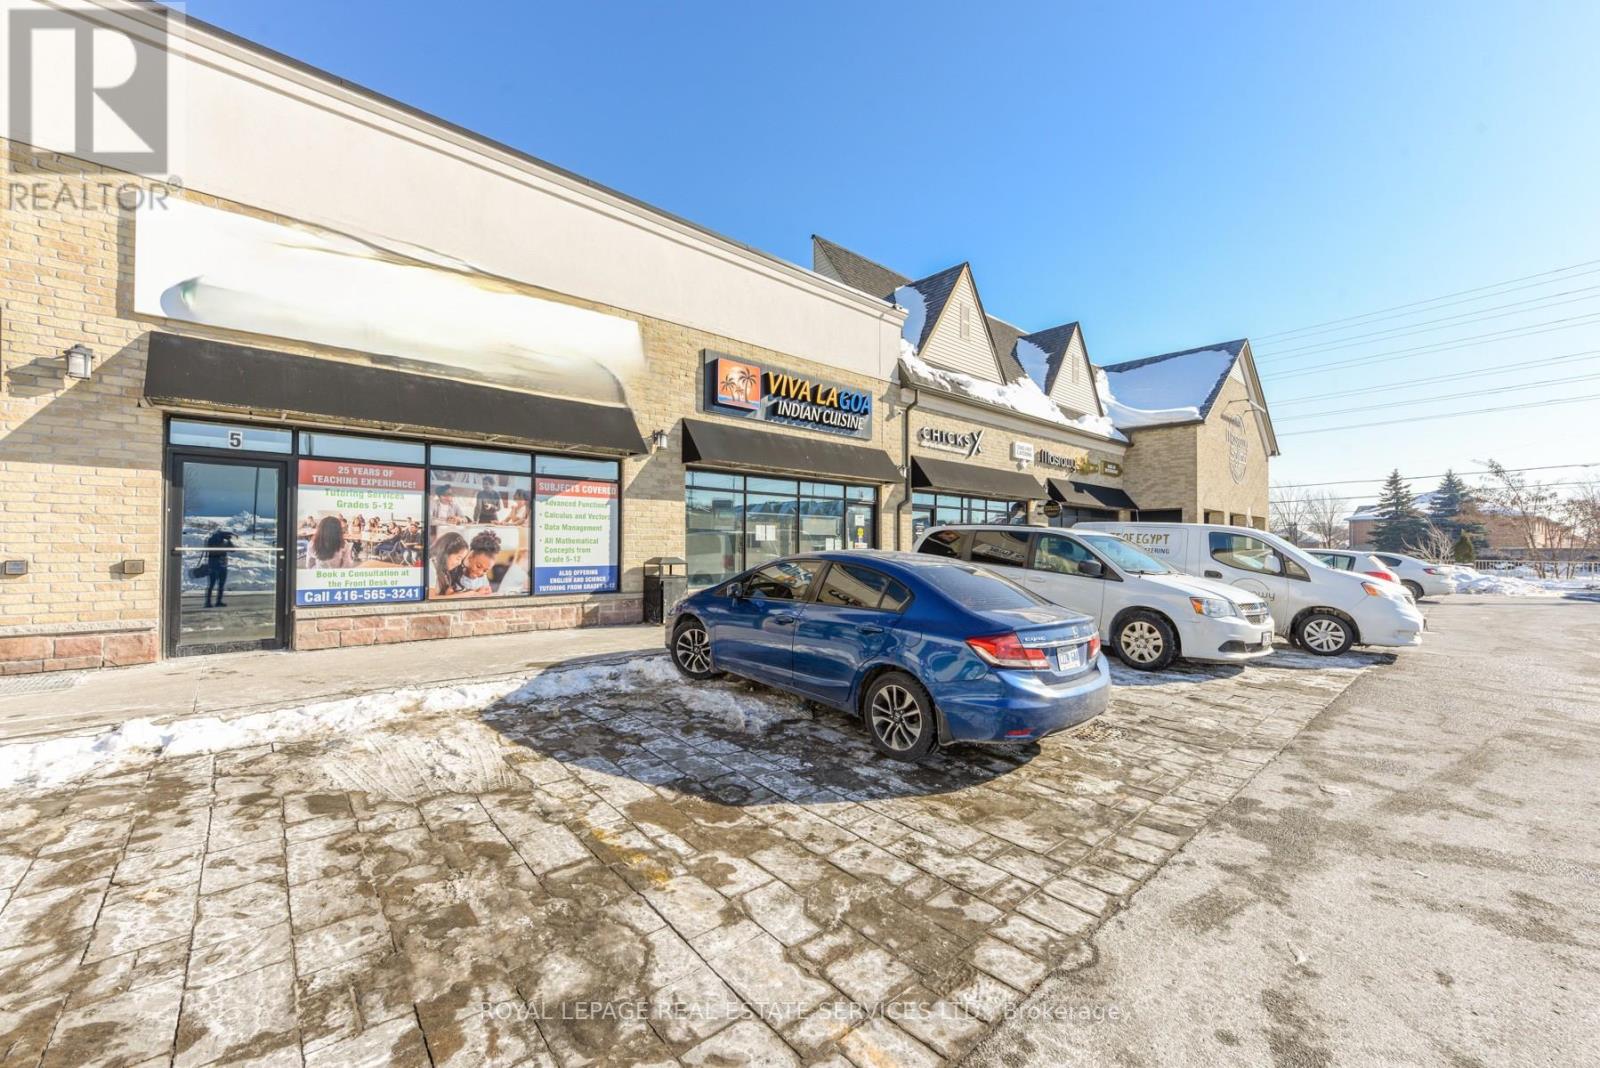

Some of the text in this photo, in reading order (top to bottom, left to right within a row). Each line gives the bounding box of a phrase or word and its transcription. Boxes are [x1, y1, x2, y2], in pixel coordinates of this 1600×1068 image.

[768, 371, 811, 401] VIVA
[777, 401, 865, 430] INDIAN CUISINE
[230, 432, 241, 448] 5
[337, 466, 395, 478] 25 YEARS OF
[312, 475, 416, 489] TEACHING EXPERIENCE!
[324, 487, 405, 500] Tutoring Services
[538, 482, 617, 495] SUBJECTS COVERED
[336, 500, 394, 510] Grades 5-12
[545, 500, 577, 508] Advanced
[544, 511, 573, 519] Calculus
[544, 523, 603, 532] Data Management
[544, 537, 599, 545] All Mathematical
[1136, 533, 1170, 545] EGYPT
[316, 570, 338, 578] Book
[348, 569, 399, 578] Consultation
[401, 569, 410, 577] at
[328, 580, 342, 588] the
[344, 579, 366, 587] Front
[539, 584, 566, 592] TUTORING
[304, 588, 419, 603] Call 416-565-3241
